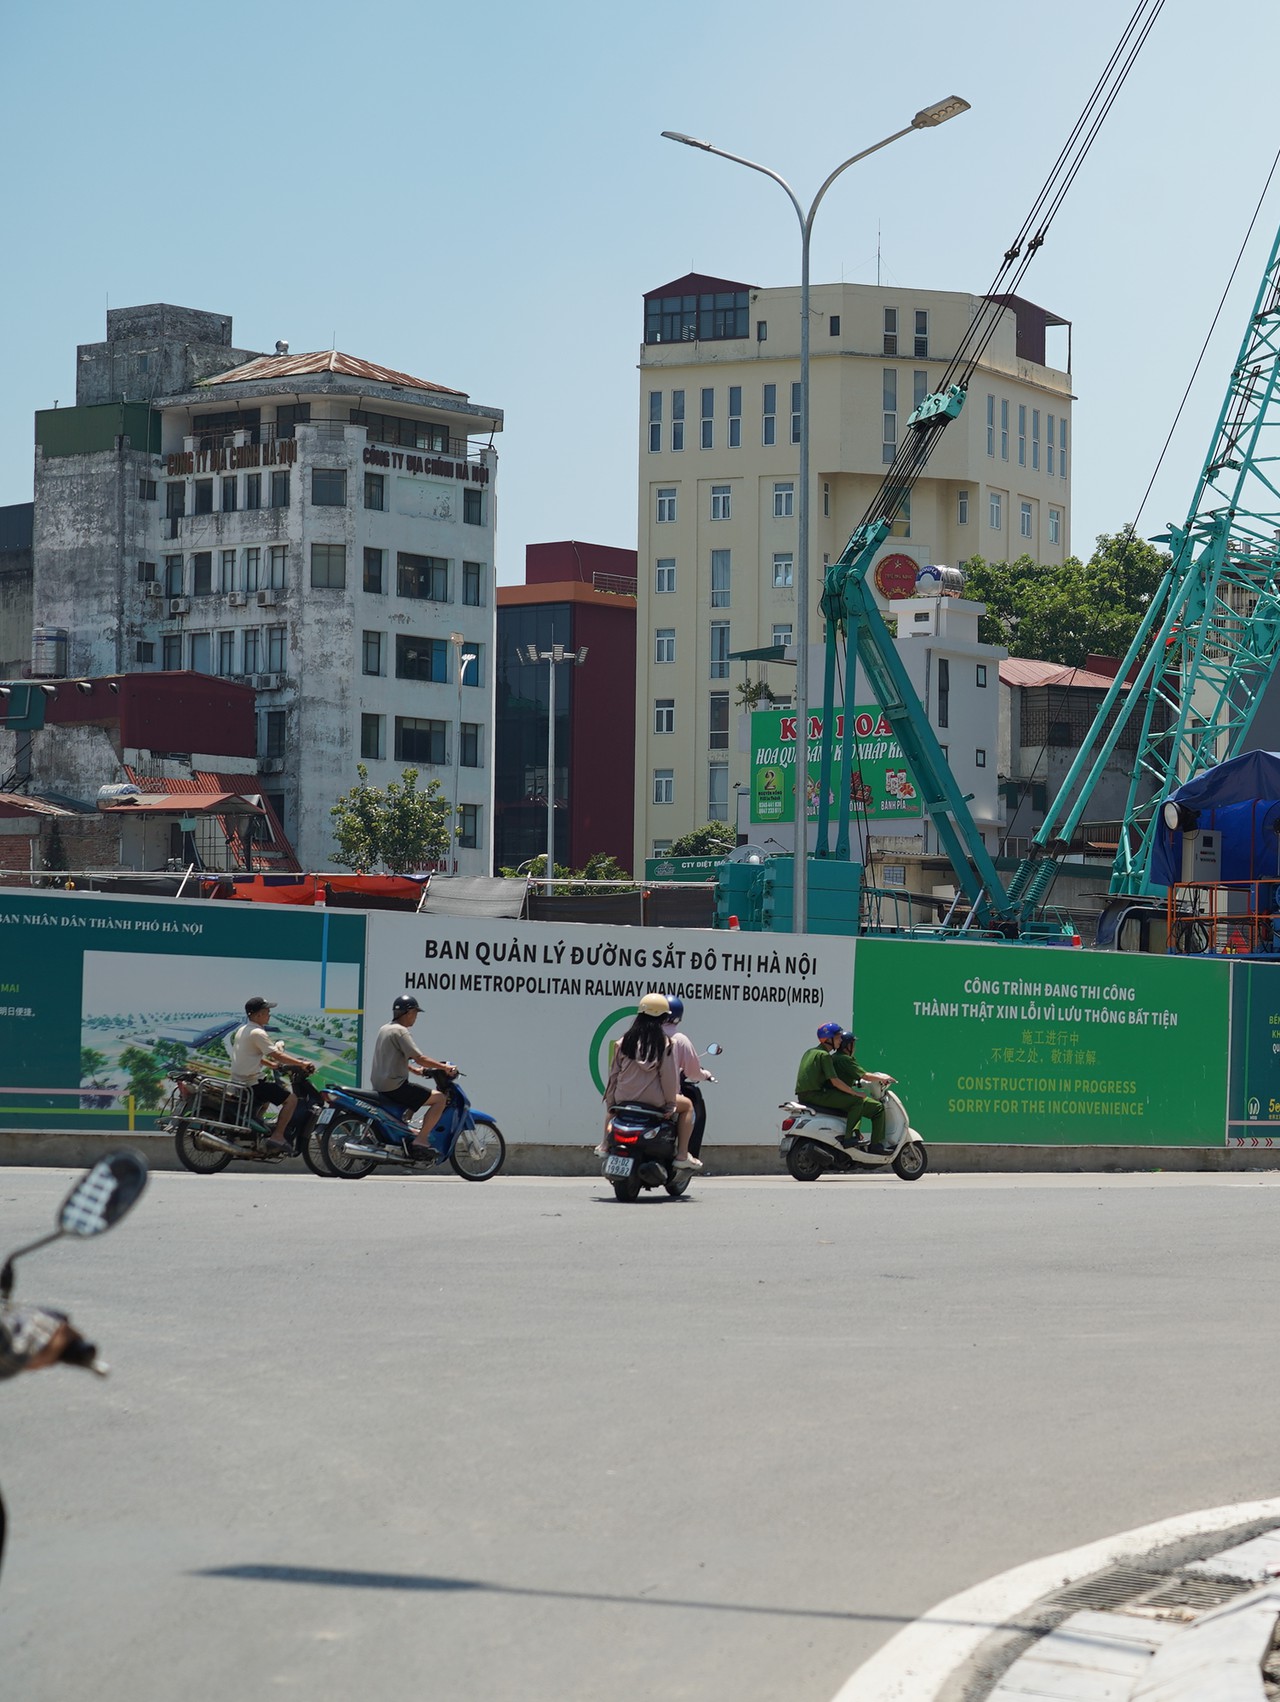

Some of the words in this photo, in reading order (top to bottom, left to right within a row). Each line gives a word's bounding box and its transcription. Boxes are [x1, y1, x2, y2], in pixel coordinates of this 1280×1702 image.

[363, 444, 390, 468] CÔNG
[391, 452, 404, 470] TY
[455, 461, 469, 481] HÀ
[472, 463, 489, 488] NỘI
[756, 747, 779, 764] HOA
[858, 738, 888, 764] NHẬP
[764, 770, 776, 790] 2
[23, 913, 58, 927] NHÂN
[61, 915, 86, 928] DÂN
[89, 917, 132, 930] THÀNH
[134, 919, 160, 932] PHỐ
[162, 920, 180, 933] HÀ
[181, 922, 204, 935] NỘI
[425, 939, 469, 960] BAN
[475, 937, 537, 966] QUẢN
[543, 940, 566, 964] LÝ
[570, 942, 647, 968] ĐƯỜNG
[652, 942, 686, 969] SẮT
[690, 948, 717, 971] ĐÔ
[722, 953, 751, 978] THỊ
[757, 951, 781, 974] HÀ
[785, 953, 817, 980] NỘI
[0, 983, 20, 993] MAI
[405, 972, 456, 991] HANOI
[460, 974, 581, 996] METROPOLITAN
[585, 979, 644, 997] RALWAY
[647, 981, 740, 1001] MANAGEMENT
[964, 977, 1000, 994] CÔNG
[1003, 978, 1042, 996] TRÌNH
[1044, 983, 1078, 998] ĐANG
[1081, 985, 1100, 999] THI
[1103, 984, 1135, 1001] CÔNG
[913, 998, 959, 1017] THÀNH
[962, 1001, 994, 1022] THẬT
[996, 1005, 1018, 1019] XIN
[1021, 1001, 1041, 1020] LỖI
[1043, 1003, 1055, 1020] VÌ
[1058, 1005, 1082, 1022] LƯU
[1084, 1006, 1126, 1024] THÔNG
[1128, 1008, 1149, 1025] BẤT
[1151, 1009, 1178, 1030] TIỆN
[957, 1076, 1055, 1093] CONSTRUCTION
[1059, 1078, 1071, 1093] IN
[1074, 1079, 1137, 1094] PROGRESS
[948, 1099, 991, 1113] SORRY
[993, 1099, 1018, 1113] FOR
[1021, 1100, 1045, 1114] THE
[1048, 1100, 1144, 1116] INCONVENIENCE
